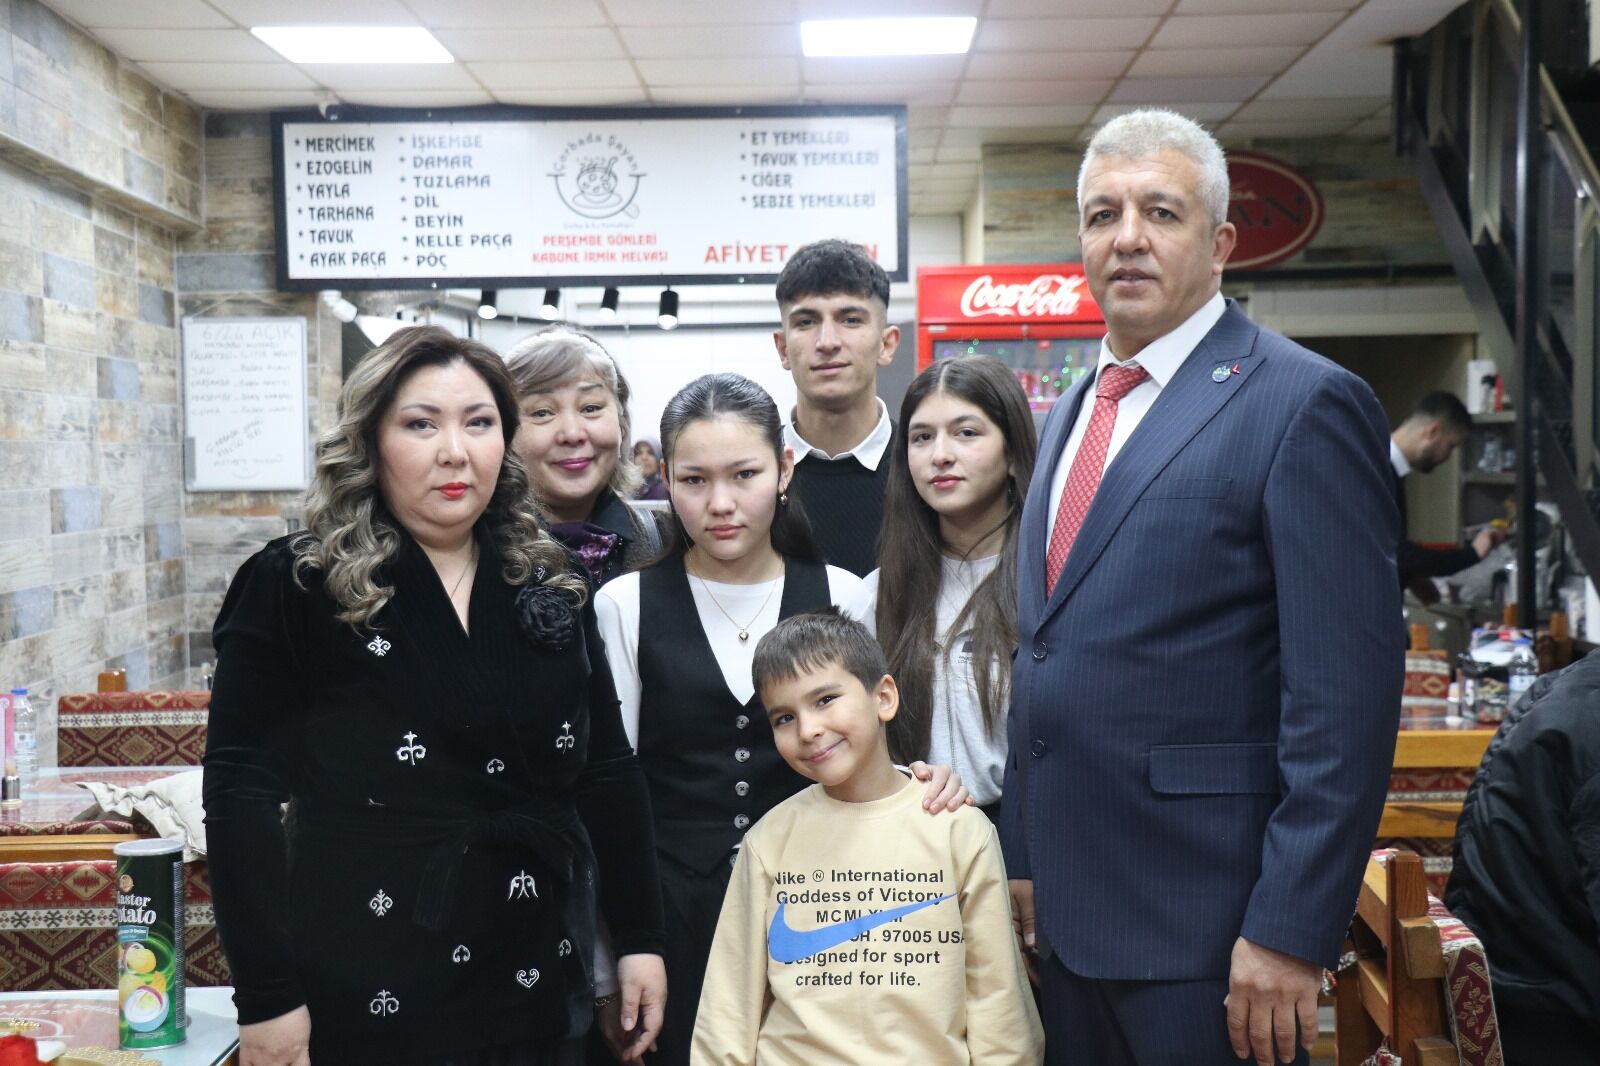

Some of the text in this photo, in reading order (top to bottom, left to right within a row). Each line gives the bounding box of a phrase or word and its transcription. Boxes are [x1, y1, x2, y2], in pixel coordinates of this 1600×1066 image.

[306, 134, 375, 153] MERCİMEK
[412, 133, 483, 152] İŞKEMBE
[751, 130, 849, 146] ET YEMEKLERİ
[307, 157, 373, 175] EZOGELİN
[412, 155, 473, 169] DAMAR
[751, 149, 880, 167] TAVUK YEMEKLERİ
[413, 175, 491, 189] TUZLAMA
[751, 171, 792, 188] CİĞER
[307, 183, 350, 199] YAYLA
[414, 193, 440, 208] DİL
[752, 192, 876, 210] SEBZE YEMEKLERİ
[308, 205, 375, 221] TARHANA
[415, 212, 463, 228] BEYİN
[309, 229, 355, 244] TAVUK
[416, 233, 513, 251] KELLE PAÇA
[543, 234, 602, 247] PERŞEMBE
[704, 240, 789, 263] AFİYET
[310, 252, 386, 270] AYAK PAÇA
[416, 252, 448, 271] PÖÇ
[775, 871, 806, 885] Nike
[831, 869, 944, 883] International
[776, 887, 944, 906] Goddess of Victory
[882, 929, 932, 943] 97005
[785, 948, 941, 967] signed for sport
[795, 971, 921, 986] crafted for life.
